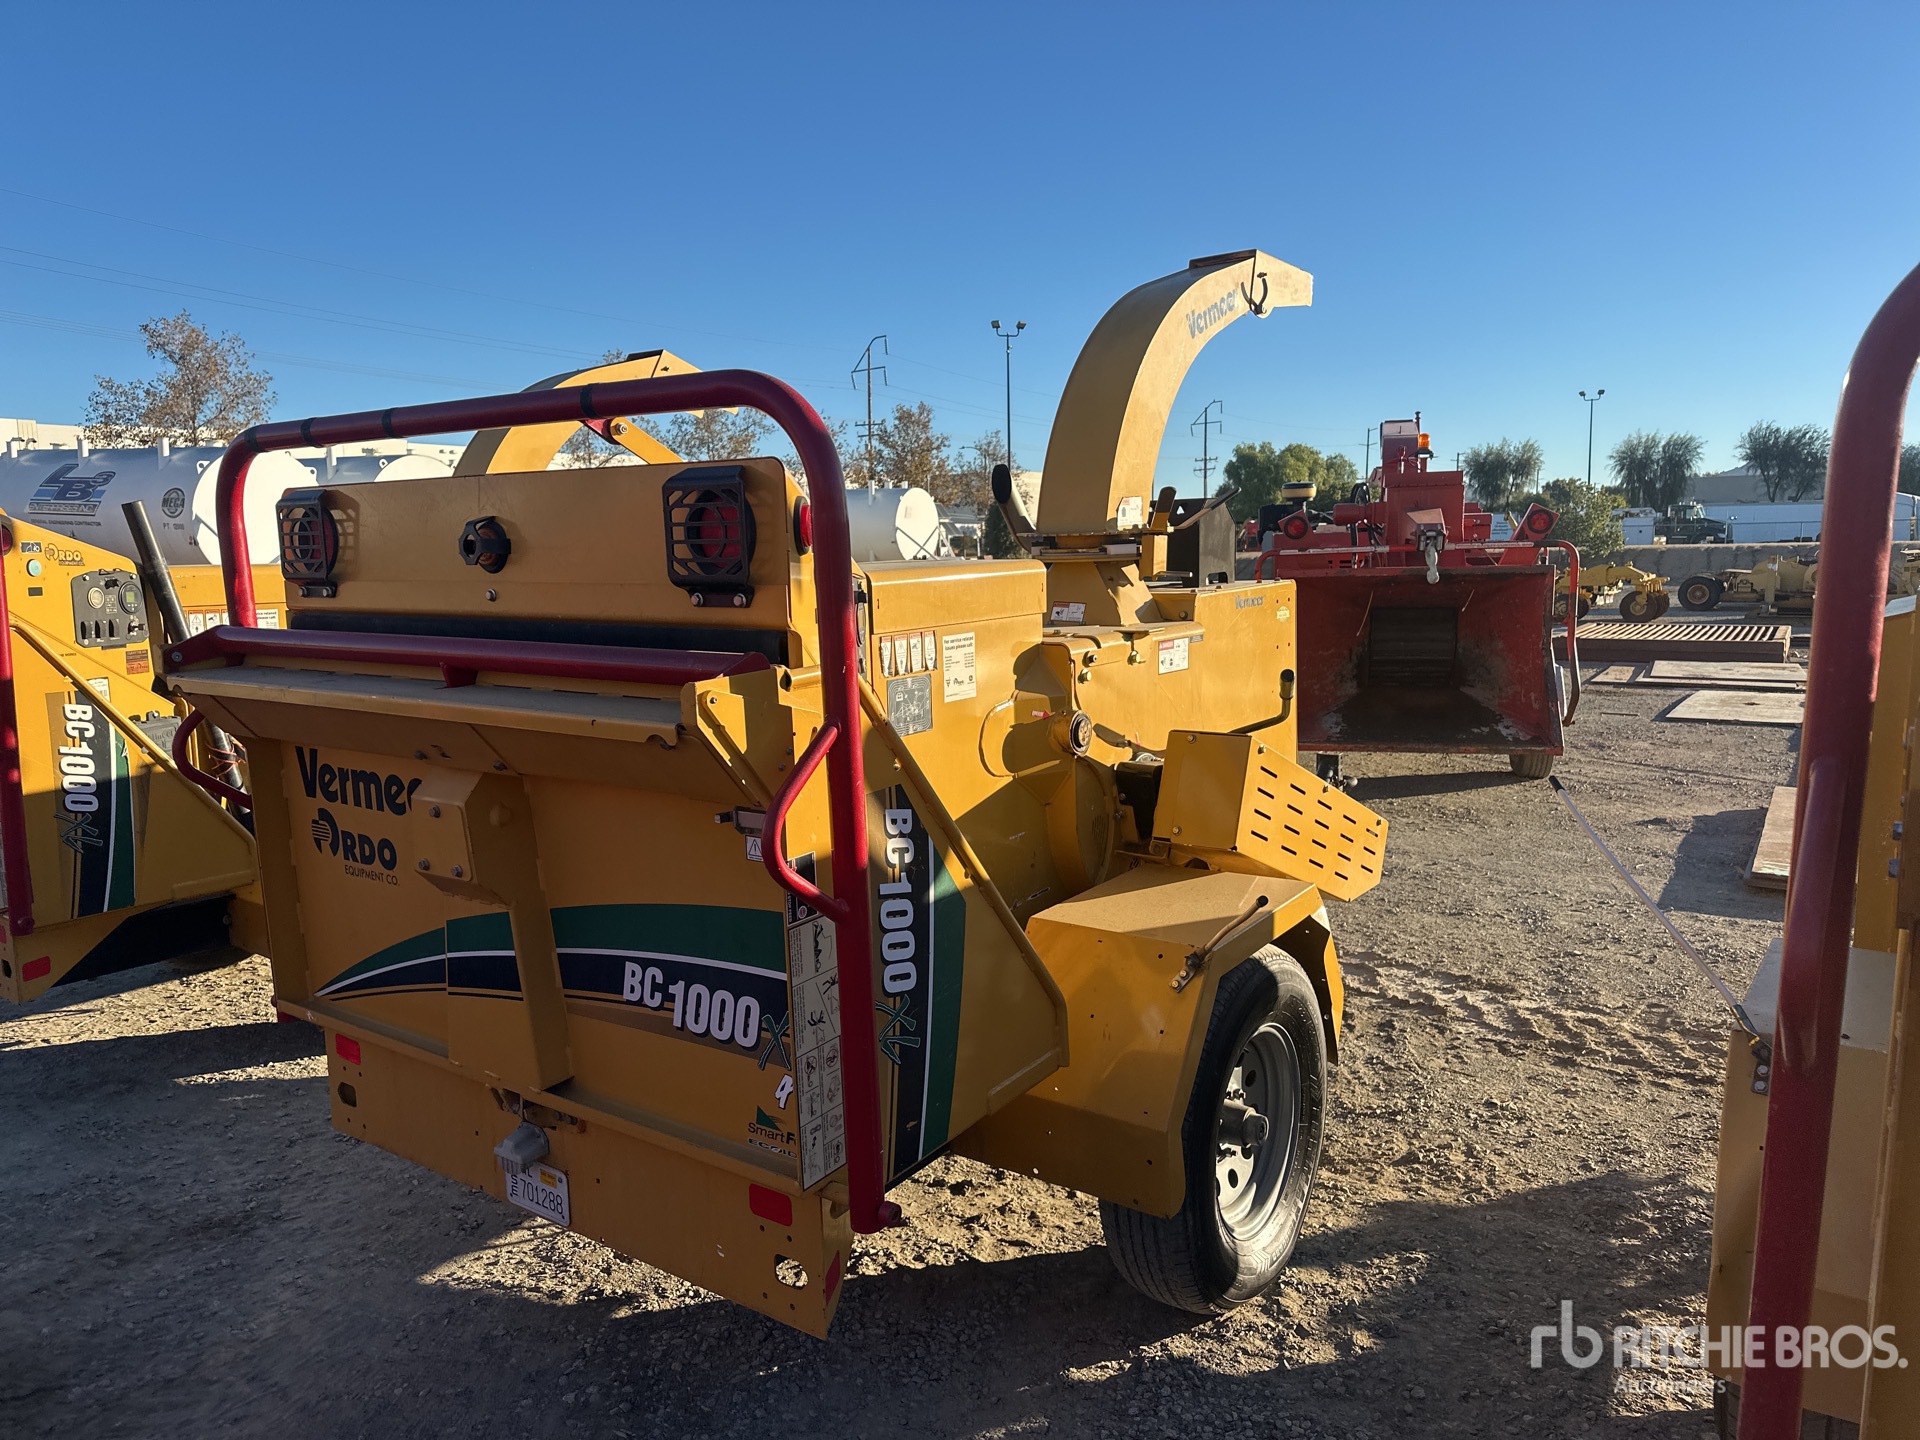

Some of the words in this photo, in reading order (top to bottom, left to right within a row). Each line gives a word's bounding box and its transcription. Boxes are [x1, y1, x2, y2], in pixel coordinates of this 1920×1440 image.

[162, 497, 185, 508] MEGA
[344, 864, 384, 882] EQUIPMENT
[386, 874, 400, 887] CO.
[520, 1178, 564, 1215] 701288
